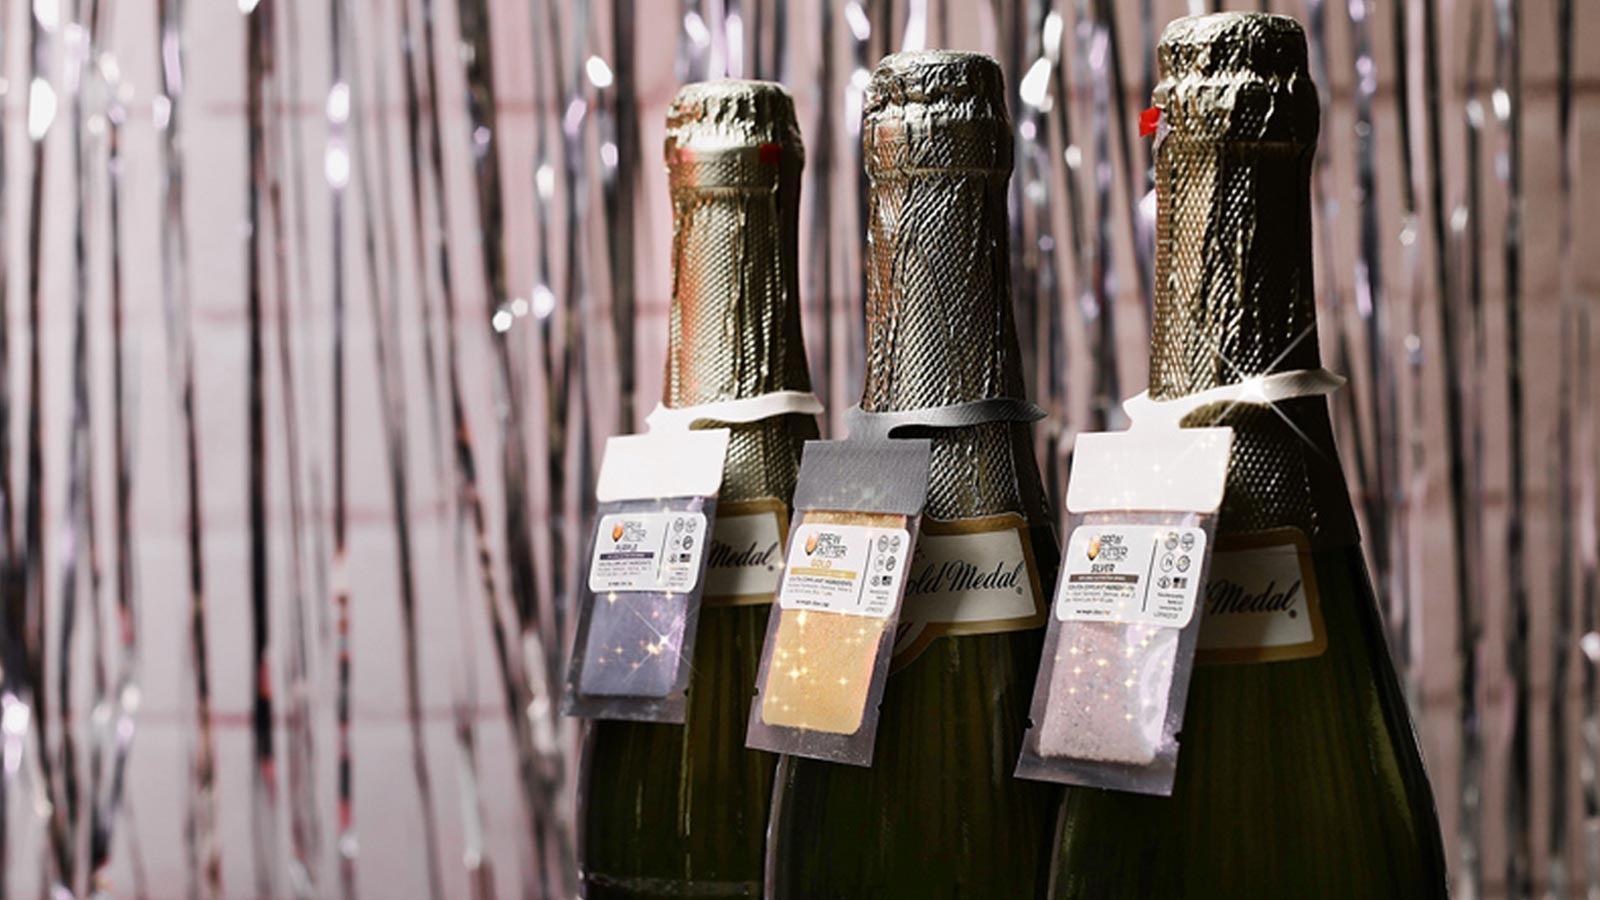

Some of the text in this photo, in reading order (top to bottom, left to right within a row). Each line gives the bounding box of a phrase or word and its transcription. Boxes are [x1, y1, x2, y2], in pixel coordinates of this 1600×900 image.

[905, 560, 1024, 596] old Medal
[1206, 579, 1301, 615] Medal
